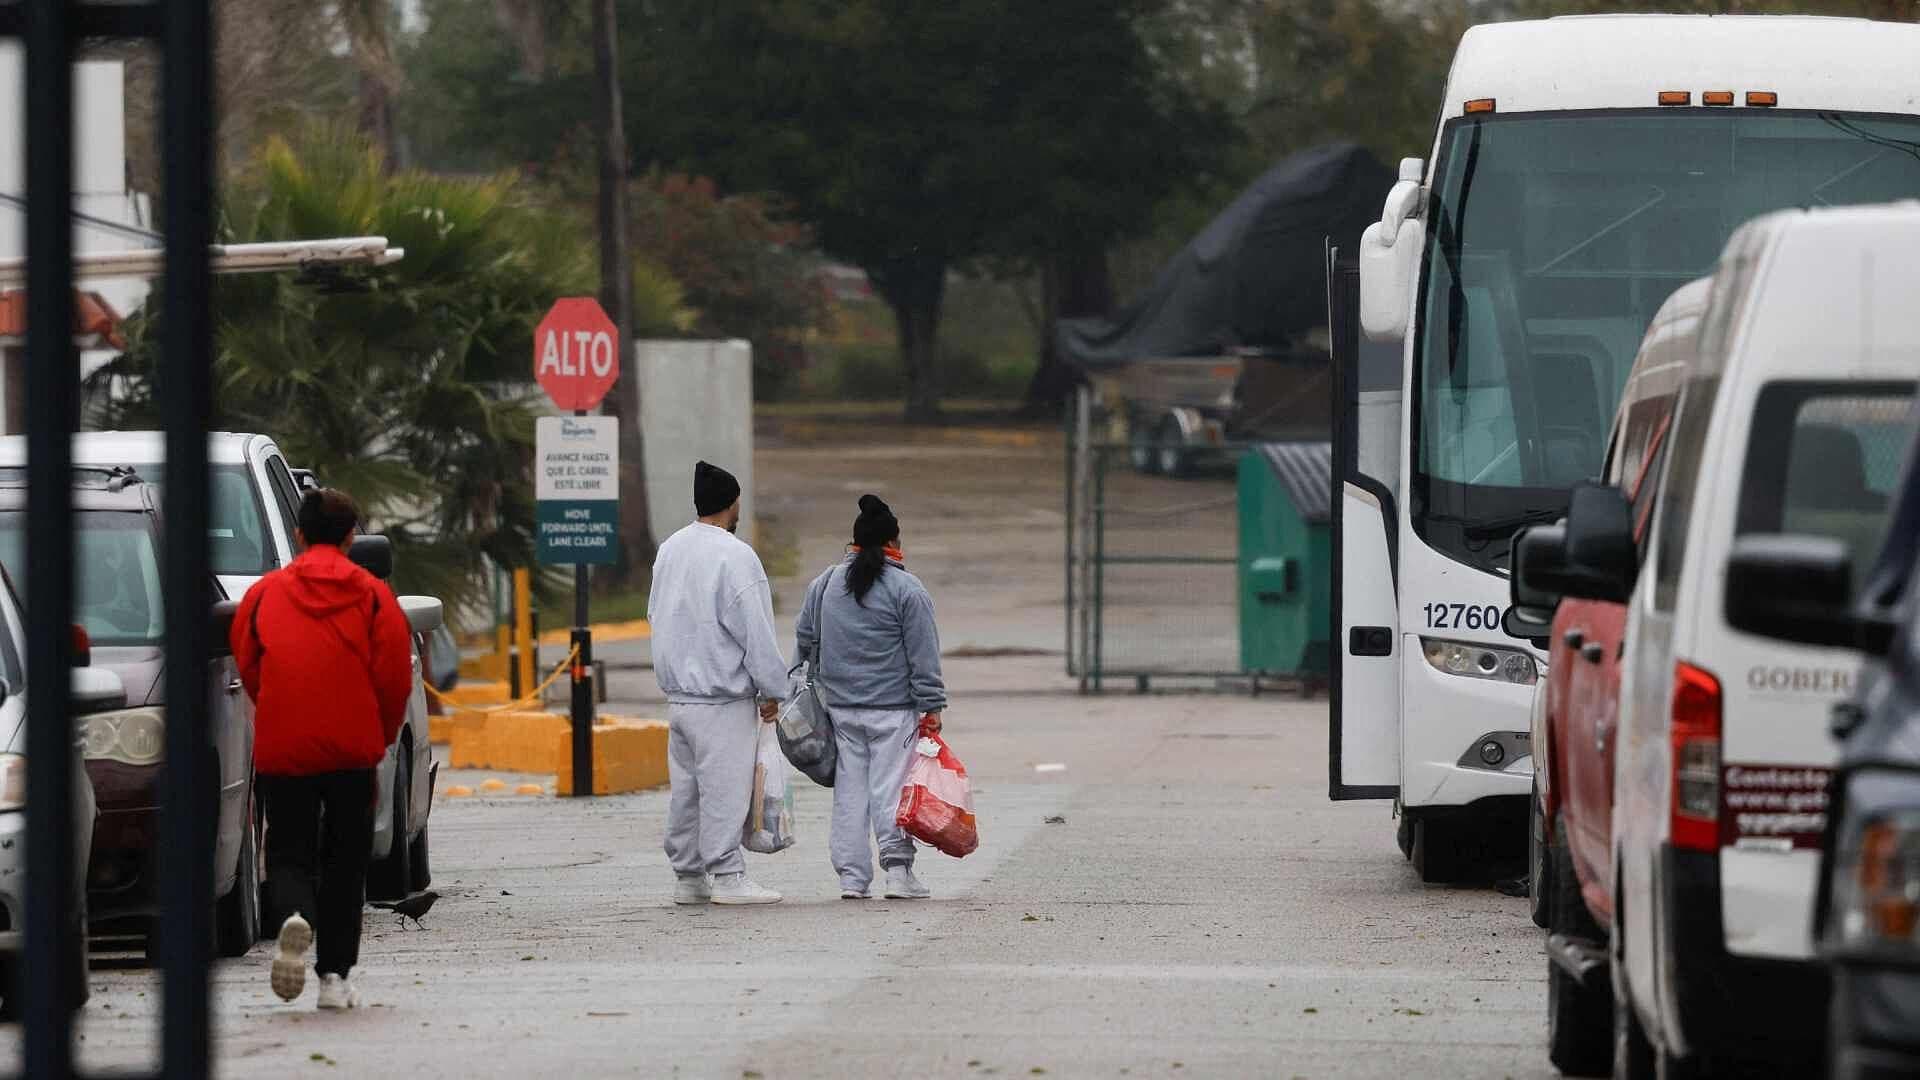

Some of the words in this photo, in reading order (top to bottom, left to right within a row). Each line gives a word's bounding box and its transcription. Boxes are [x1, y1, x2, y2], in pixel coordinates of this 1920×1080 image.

[539, 330, 613, 377] ALTO
[546, 452, 580, 462] AVANCE
[582, 452, 609, 462] HASTA
[546, 466, 564, 477] QUE
[567, 466, 577, 476] EL
[579, 466, 609, 476] CARRIL
[577, 480, 601, 489] LIBRE
[564, 509, 591, 519] MOVE
[542, 523, 587, 533] FORWARD
[588, 523, 614, 534] UNTIL
[549, 536, 571, 546] LANE
[573, 536, 607, 546] CLEARS
[1424, 603, 1500, 630] 12760
